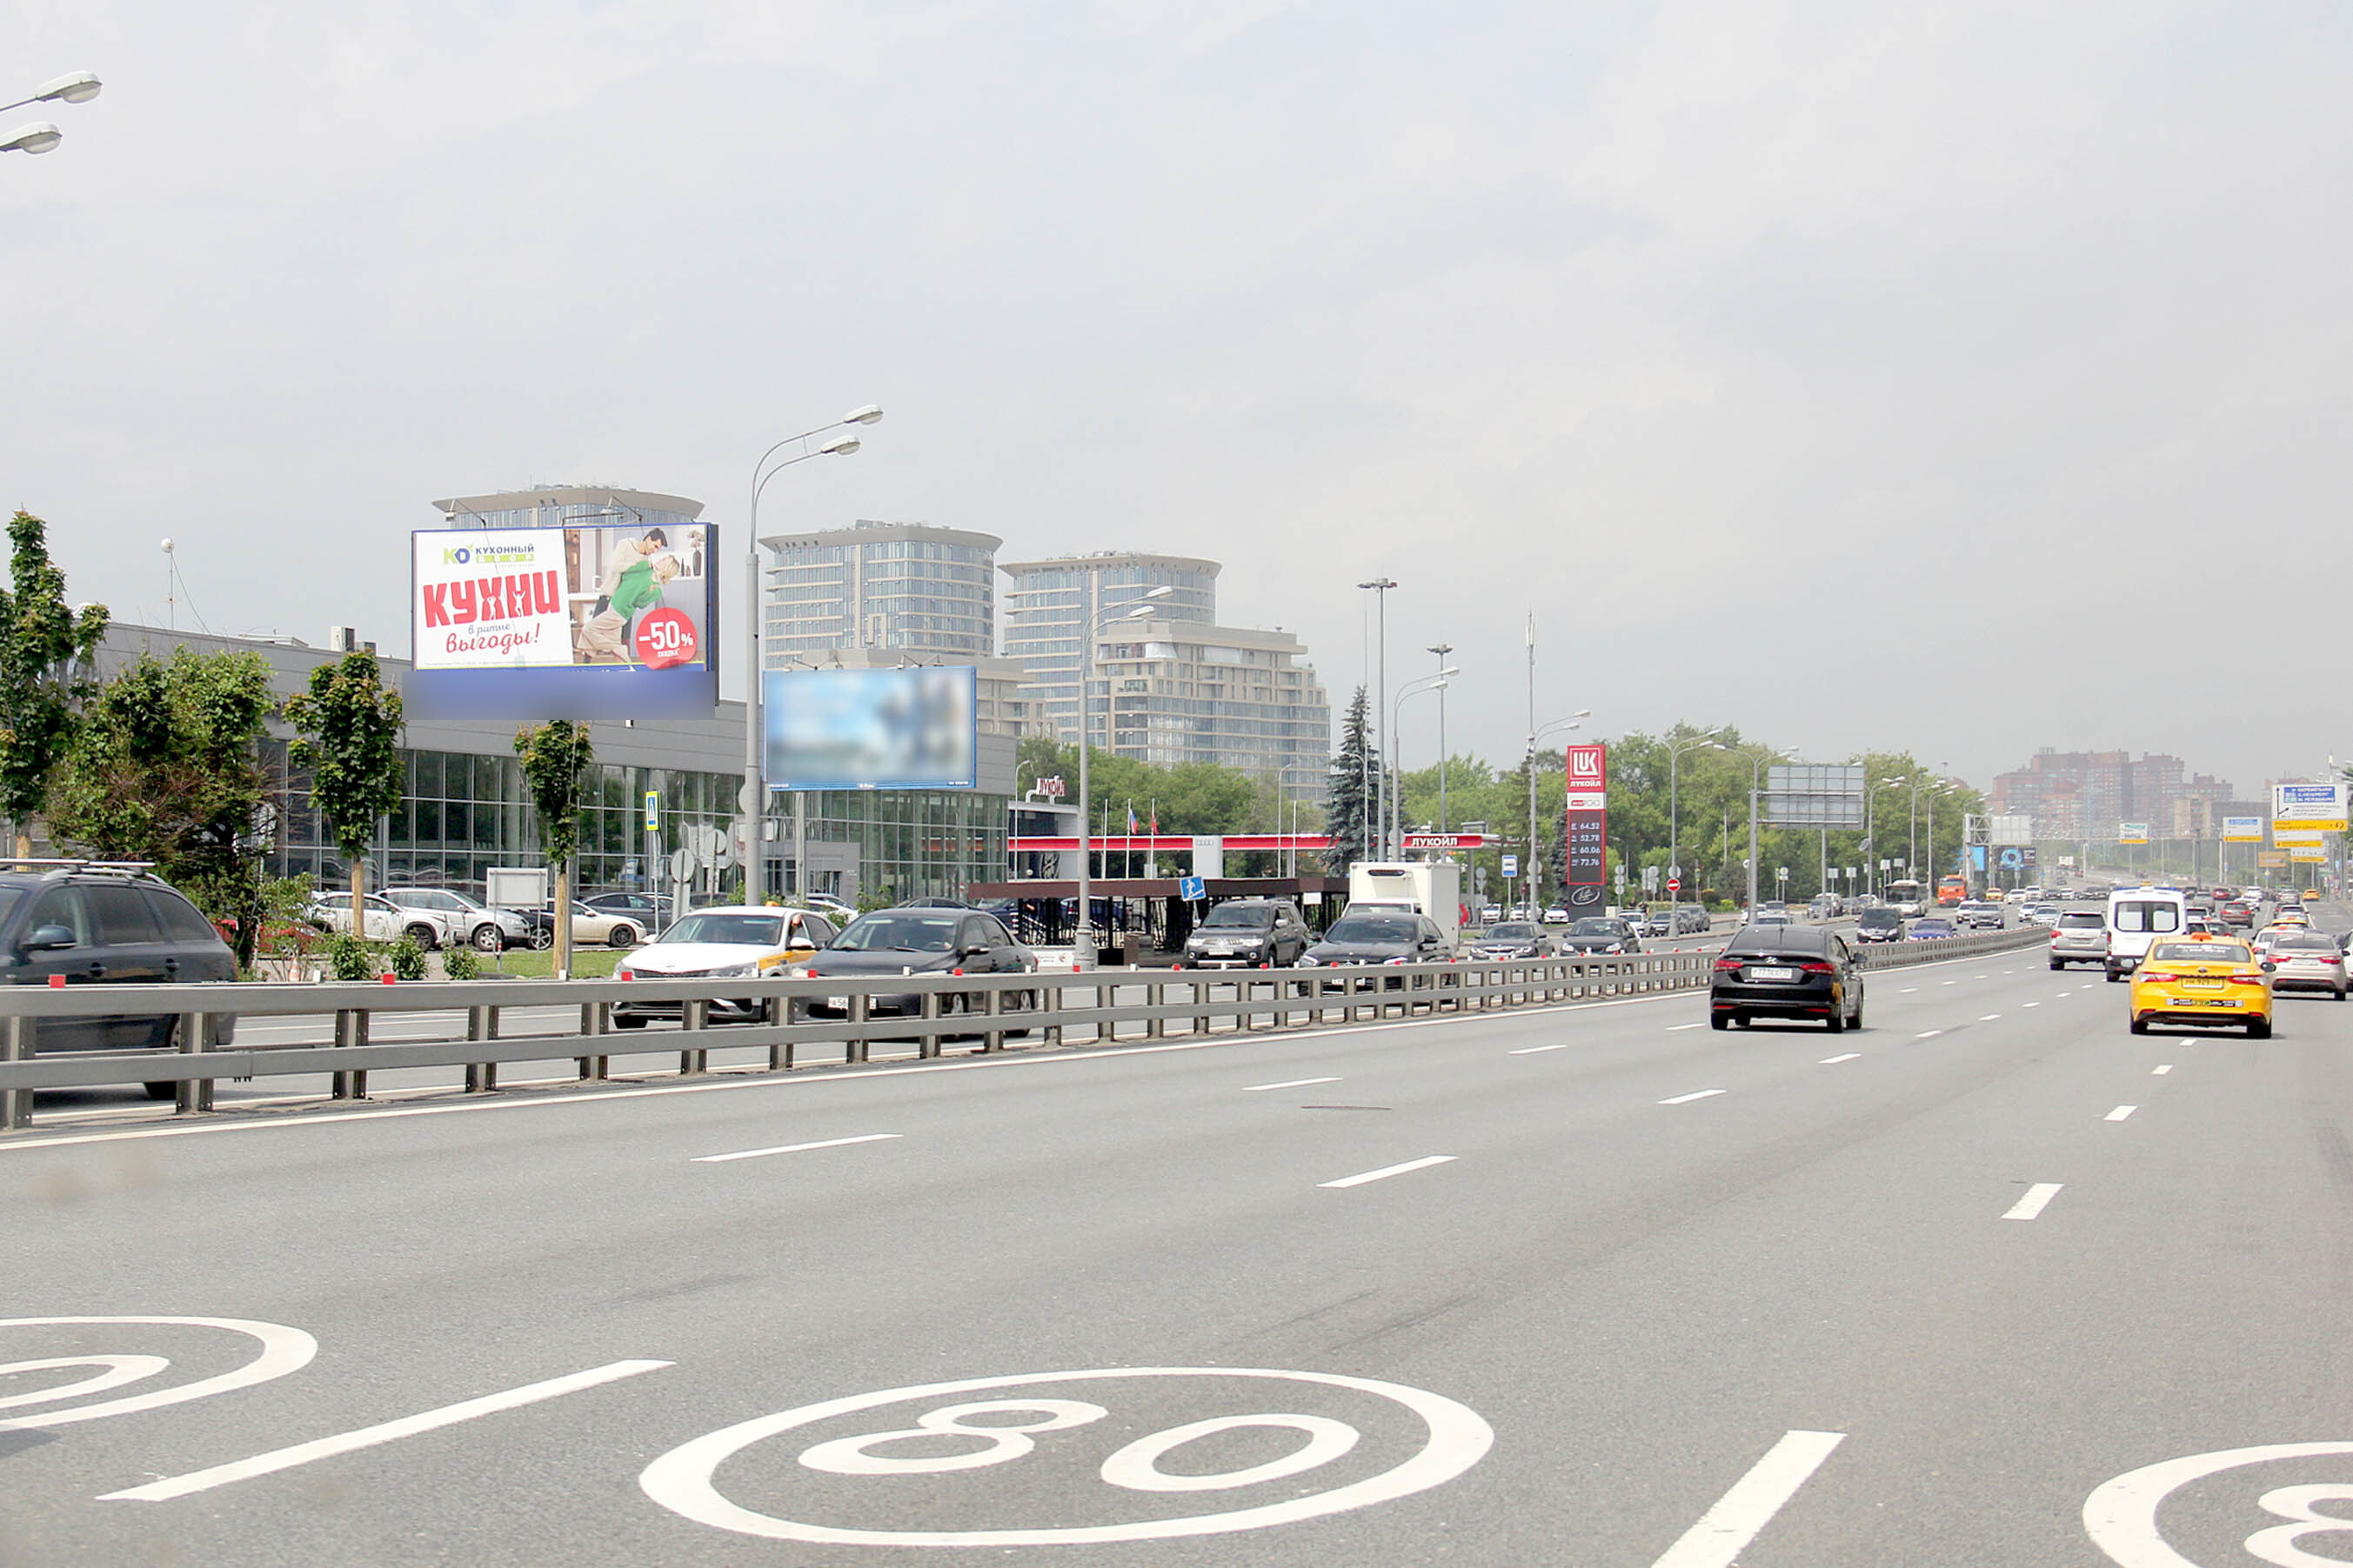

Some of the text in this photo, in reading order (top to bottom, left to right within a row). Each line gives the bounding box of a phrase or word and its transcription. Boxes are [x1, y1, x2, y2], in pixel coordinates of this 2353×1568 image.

[476, 544, 534, 555] КУХОННЫЙ
[423, 570, 561, 628] КУХНИ
[445, 623, 541, 655] выгоды!
[468, 623, 511, 637] в ритме
[638, 620, 694, 651] -50%
[1412, 835, 1458, 846] ЛУКОЙЛ
[797, 1398, 1360, 1492] 80
